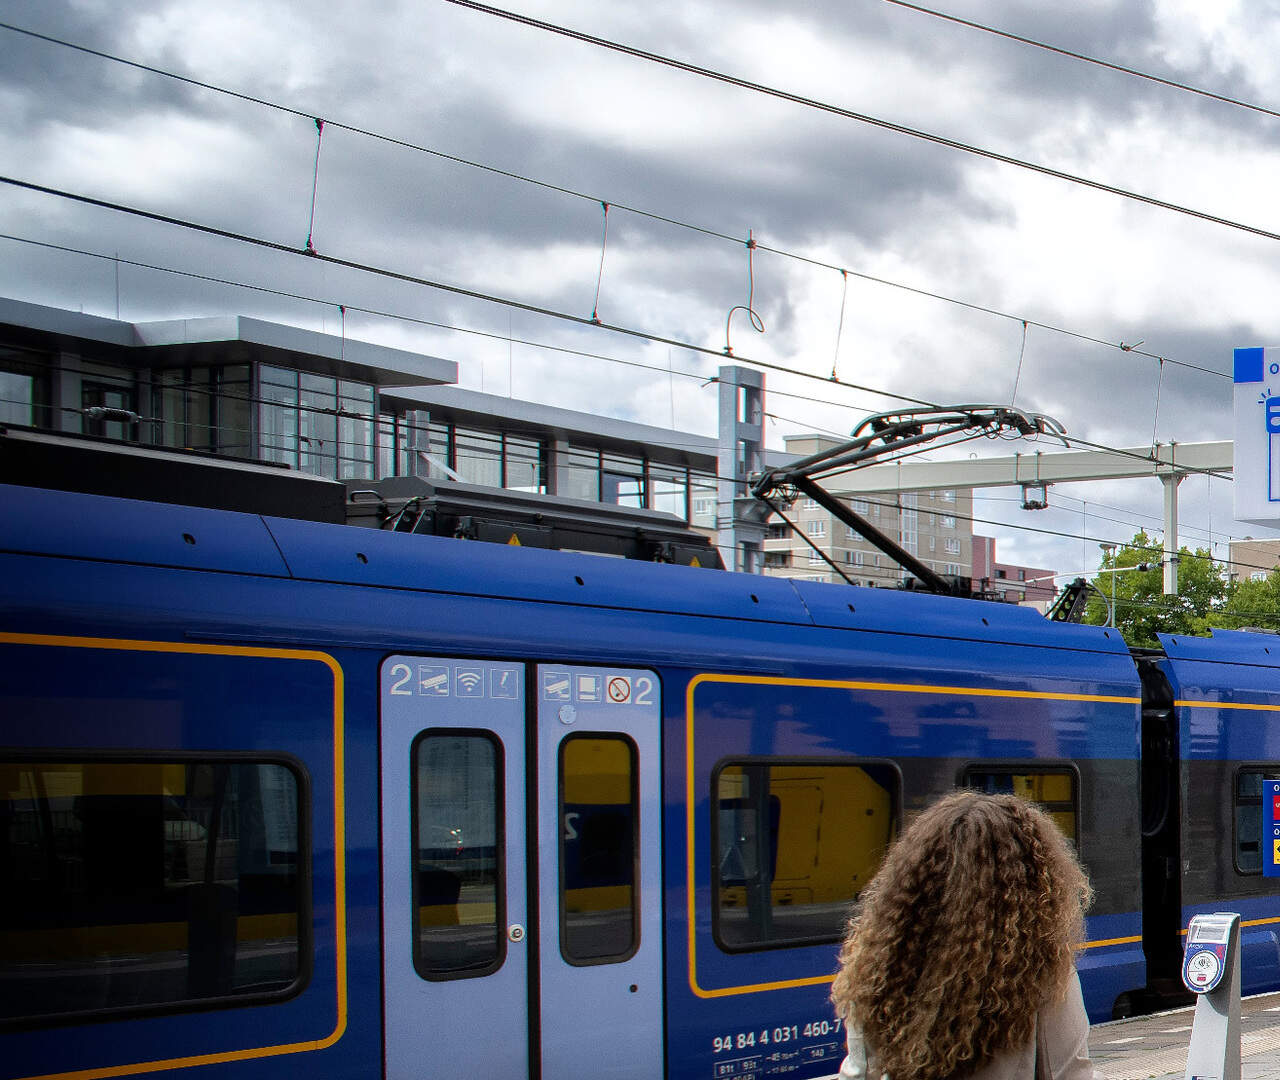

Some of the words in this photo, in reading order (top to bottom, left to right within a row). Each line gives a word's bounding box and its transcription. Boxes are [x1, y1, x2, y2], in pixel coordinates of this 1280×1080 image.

[390, 663, 413, 696] 2
[635, 677, 653, 705] 2
[713, 1036, 732, 1053] 94
[736, 1032, 756, 1049] 84
[760, 1030, 769, 1045] 4
[773, 1025, 798, 1043] 031
[803, 1018, 841, 1038] 460-7
